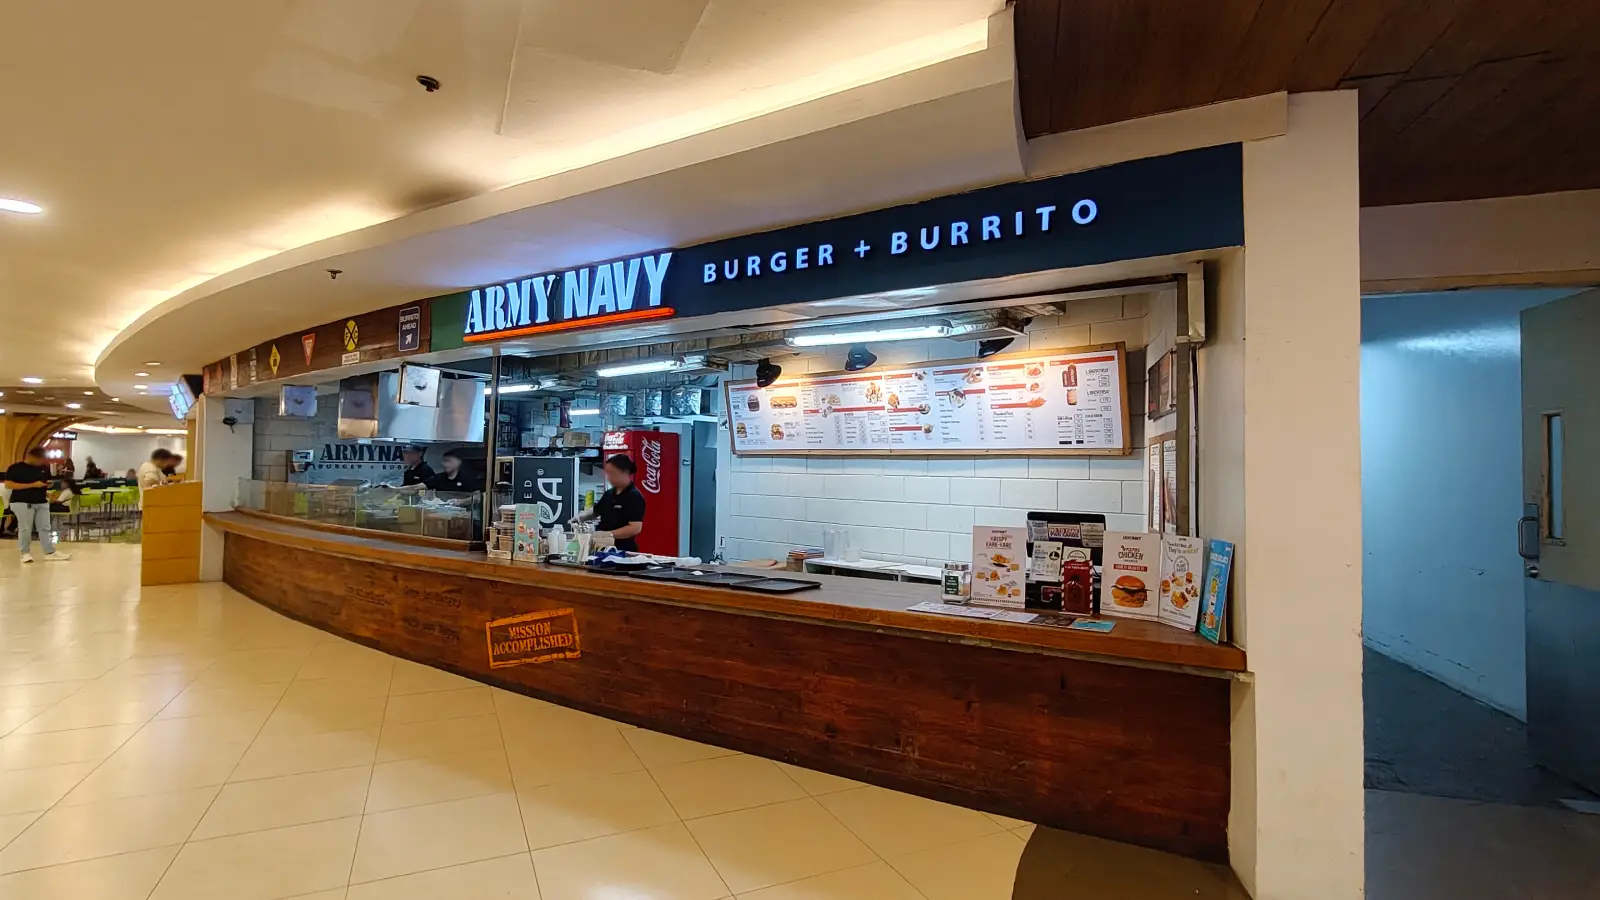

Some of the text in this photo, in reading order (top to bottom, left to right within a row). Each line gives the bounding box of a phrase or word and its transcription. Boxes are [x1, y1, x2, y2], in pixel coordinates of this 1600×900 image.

[703, 244, 834, 283] BURGER
[890, 198, 1098, 255] BURRITO
[464, 252, 673, 335] ARMY NAVY
[400, 313, 419, 322] BURRITO
[402, 322, 417, 331] AHEAD
[1118, 551, 1144, 561] CHICKEN
[508, 622, 551, 639] MISSION
[493, 634, 573, 655] ACCOMPLISHED
